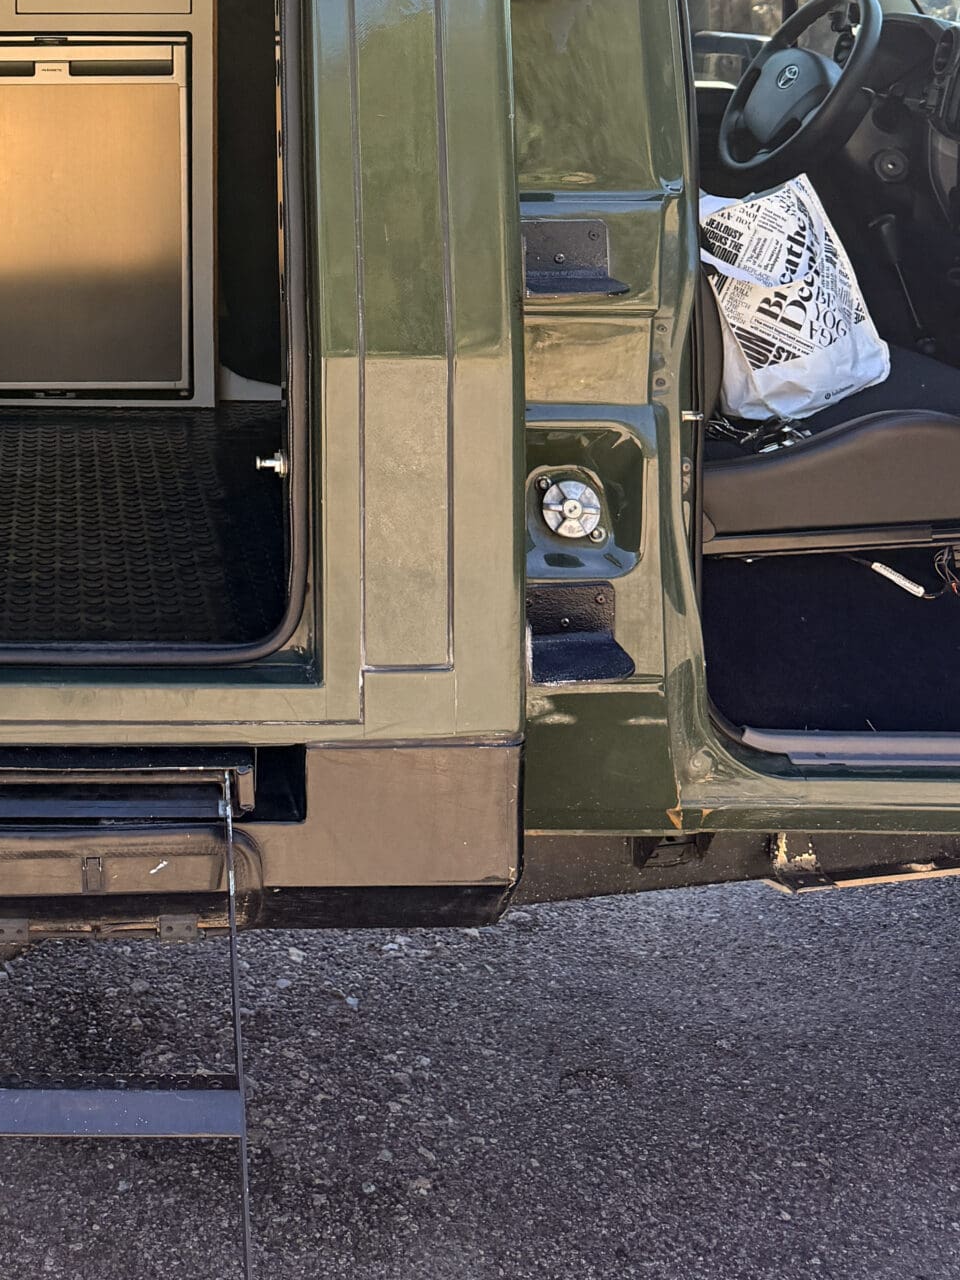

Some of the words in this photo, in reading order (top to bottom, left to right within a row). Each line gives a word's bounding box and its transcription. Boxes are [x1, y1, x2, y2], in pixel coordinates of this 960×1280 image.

[704, 226, 730, 246] WORKS
[727, 239, 744, 253] THE
[705, 217, 744, 241] JEALOUSY
